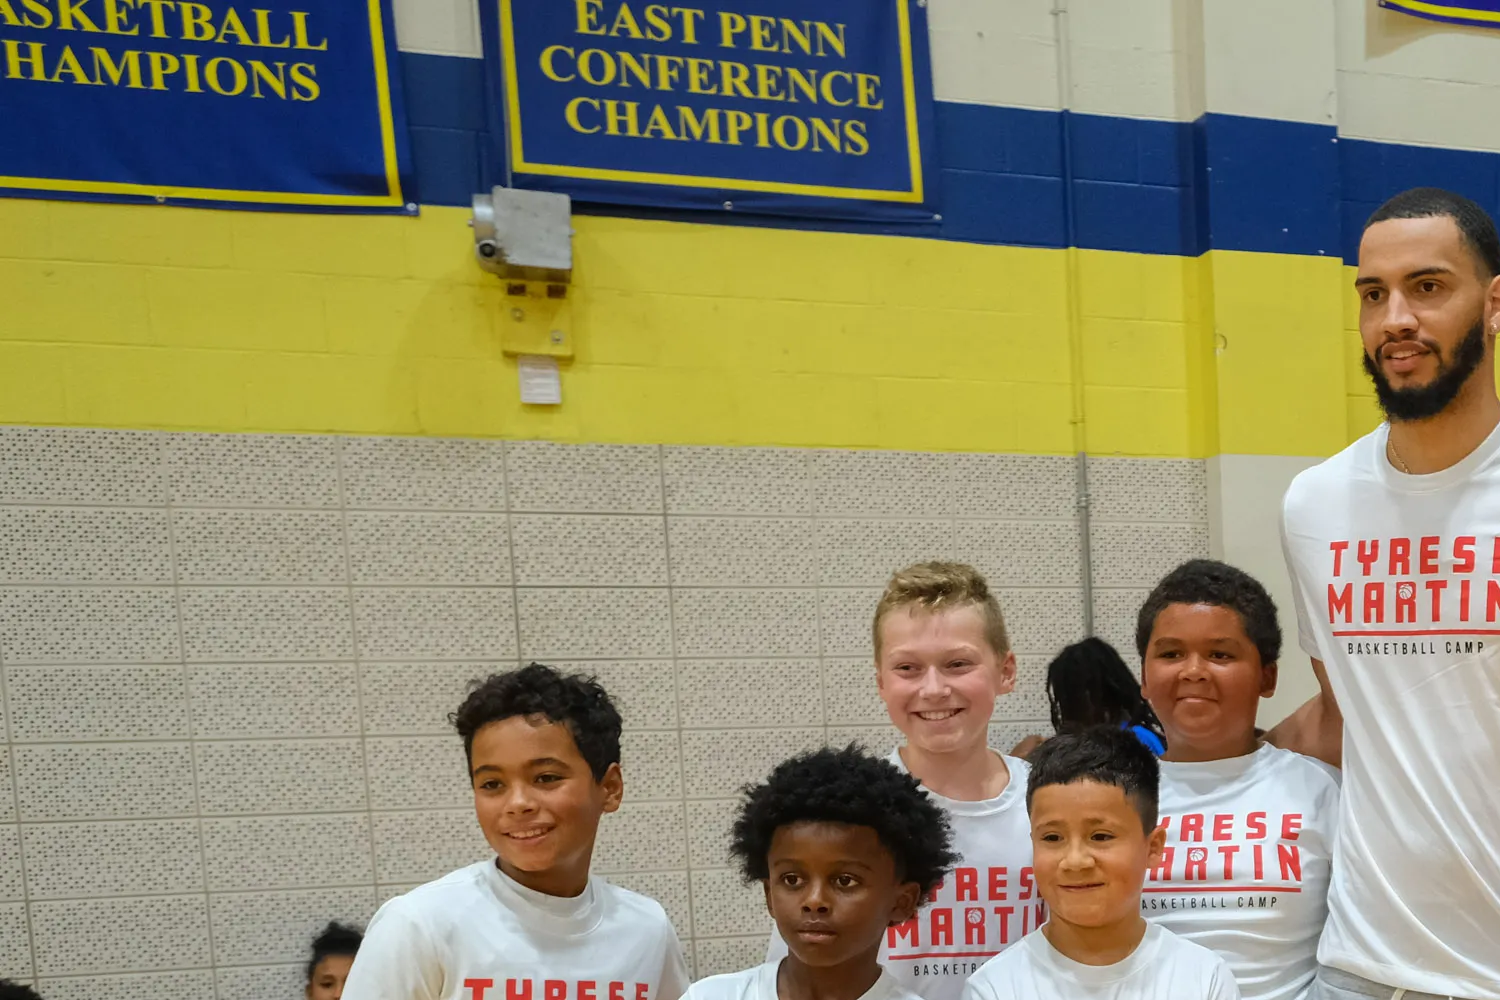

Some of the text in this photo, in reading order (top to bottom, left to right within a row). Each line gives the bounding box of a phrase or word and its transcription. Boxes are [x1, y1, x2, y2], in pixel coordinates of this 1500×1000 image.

[574, 0, 847, 59] EAST PENN
[539, 45, 885, 110] CONFERENCE
[564, 96, 870, 156] CHAMPIONS
[1347, 641, 1485, 655] BASKETBALL CAMP
[1157, 811, 1303, 842] RESE
[1148, 843, 1303, 882] ARTIN
[1142, 896, 1278, 910] ASKETBALL CAMP
[913, 963, 984, 976] BASKETB
